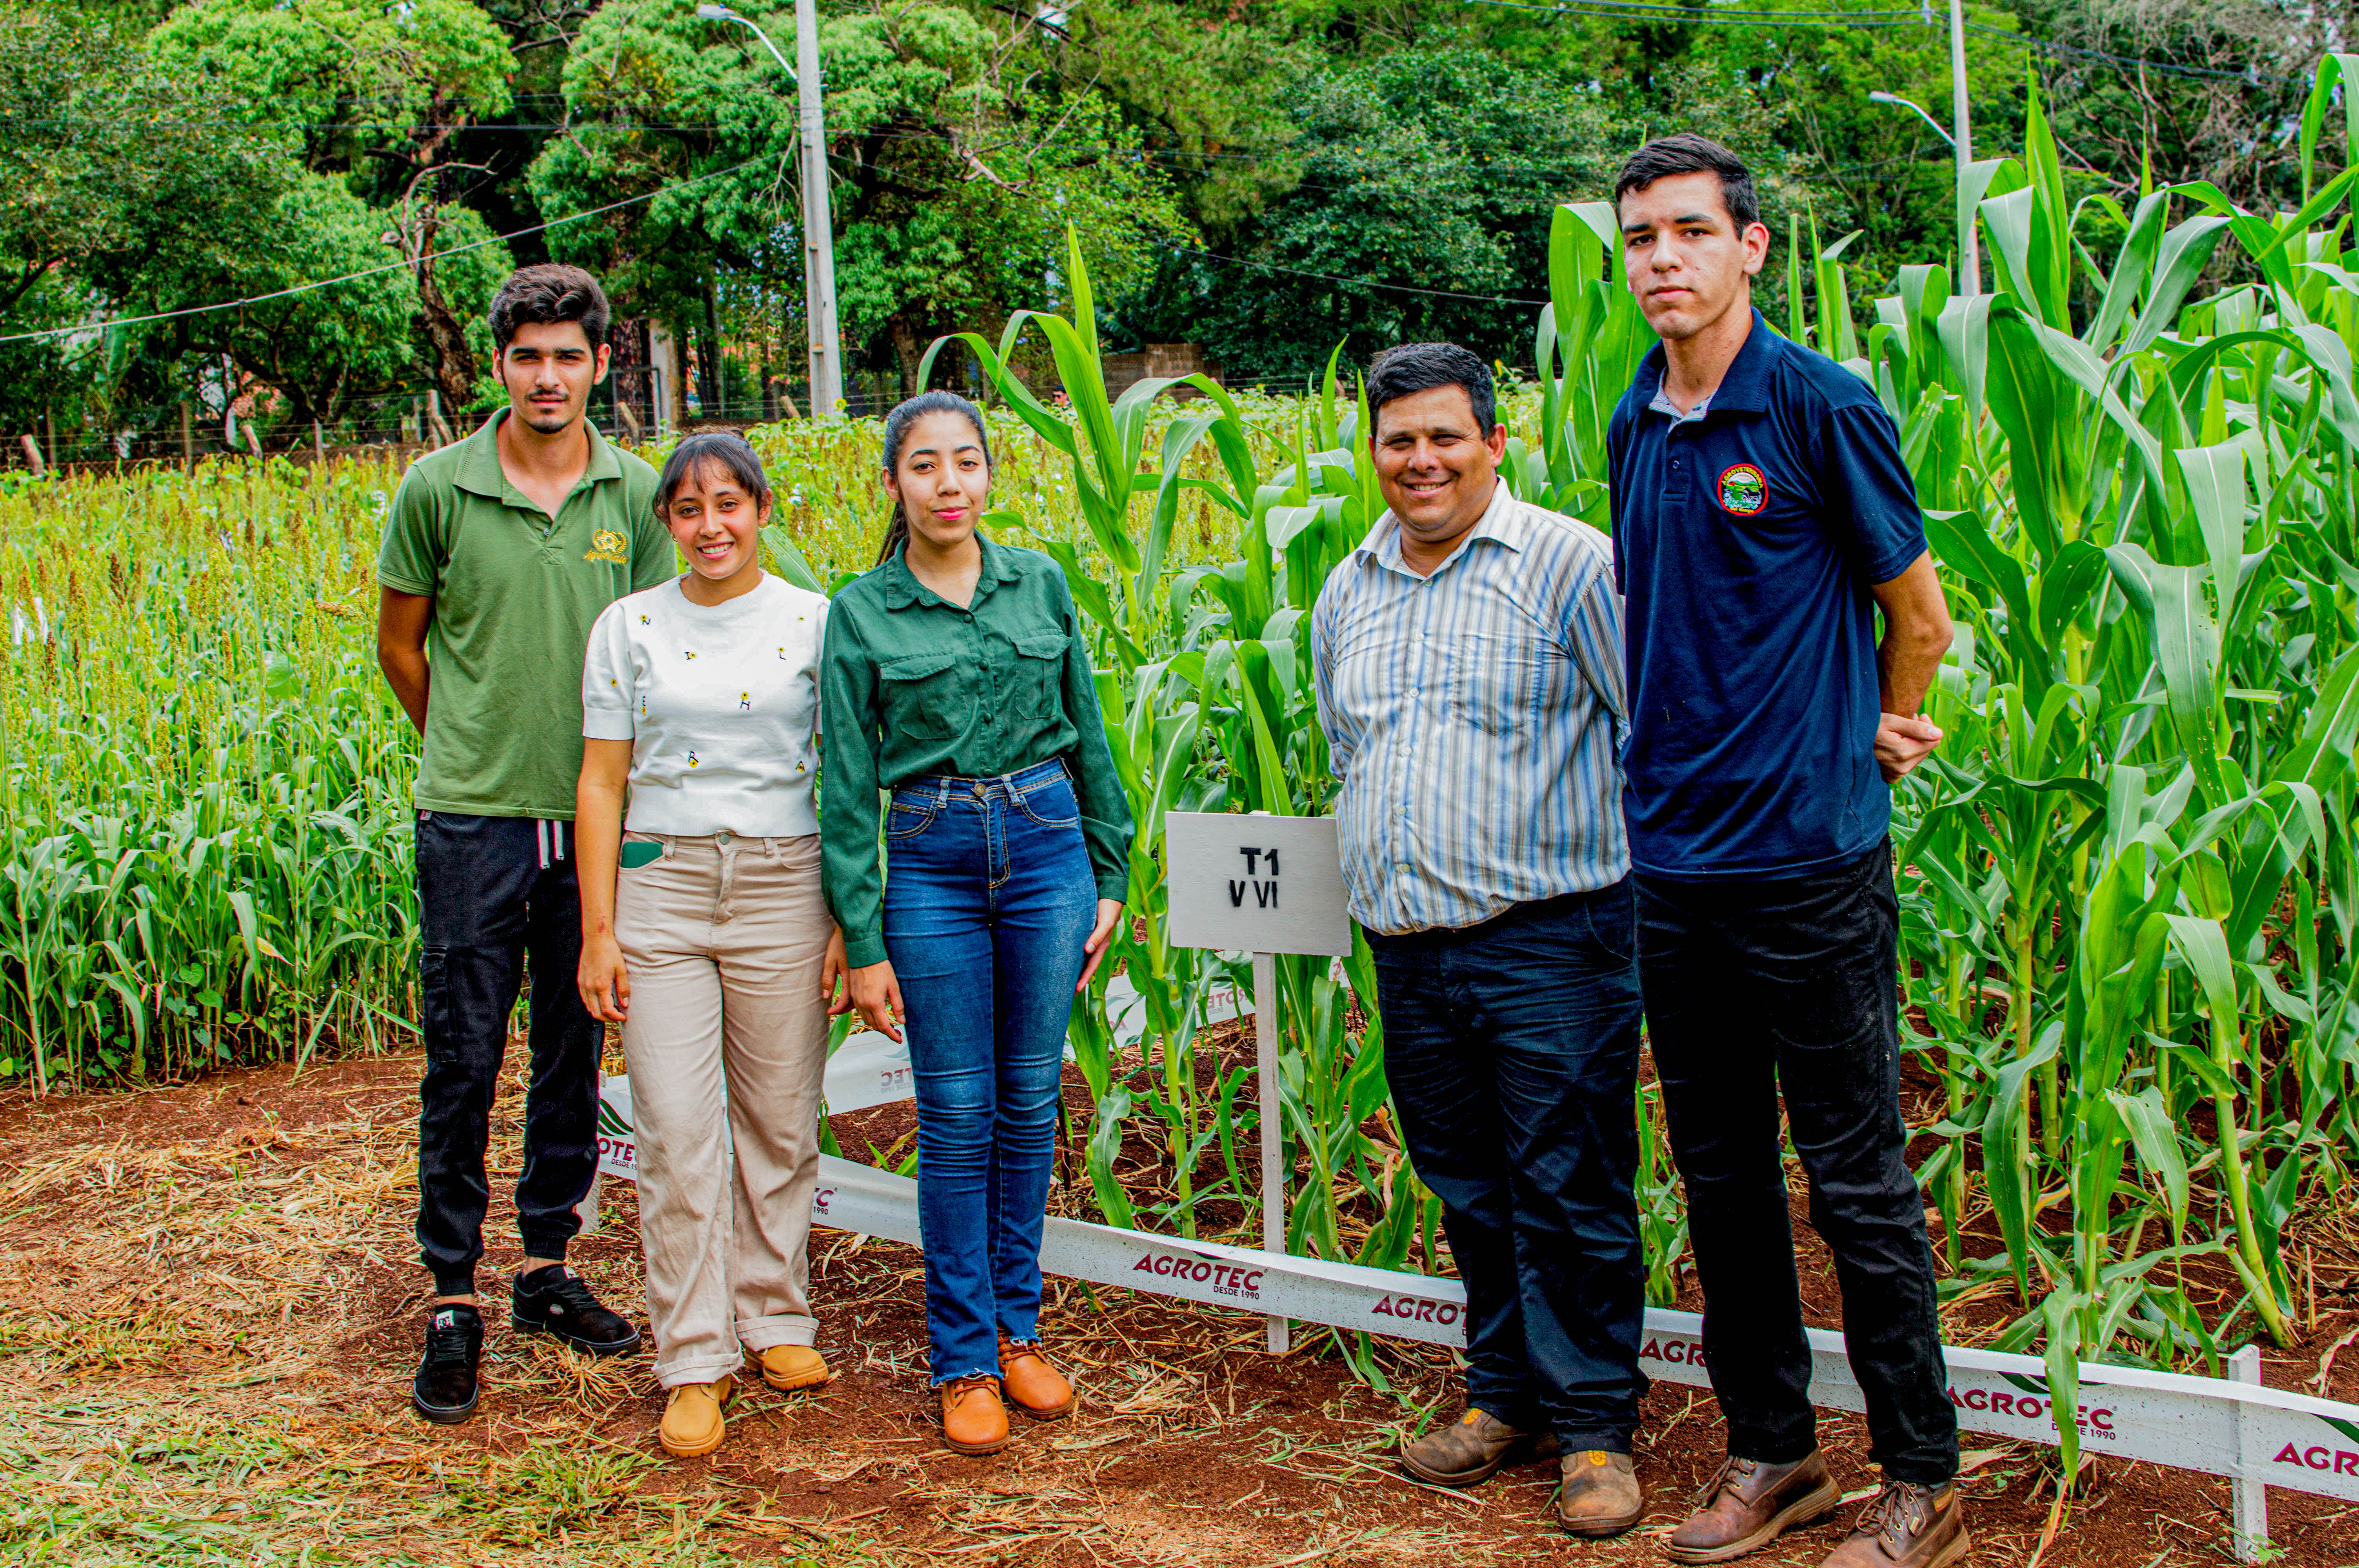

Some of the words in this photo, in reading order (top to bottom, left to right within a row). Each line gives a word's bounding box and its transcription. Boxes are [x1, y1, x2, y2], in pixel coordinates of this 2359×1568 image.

[1240, 847, 1279, 876] T1
[1229, 880, 1246, 907] V
[1253, 881, 1278, 908] VI
[611, 1158, 630, 1168] DESDE
[813, 1206, 829, 1215] 1990
[1132, 1253, 1264, 1291] AGROTEC
[1213, 1285, 1239, 1296] DESDE
[1241, 1289, 1259, 1300] 1990
[2090, 1428, 2116, 1440] 1990
